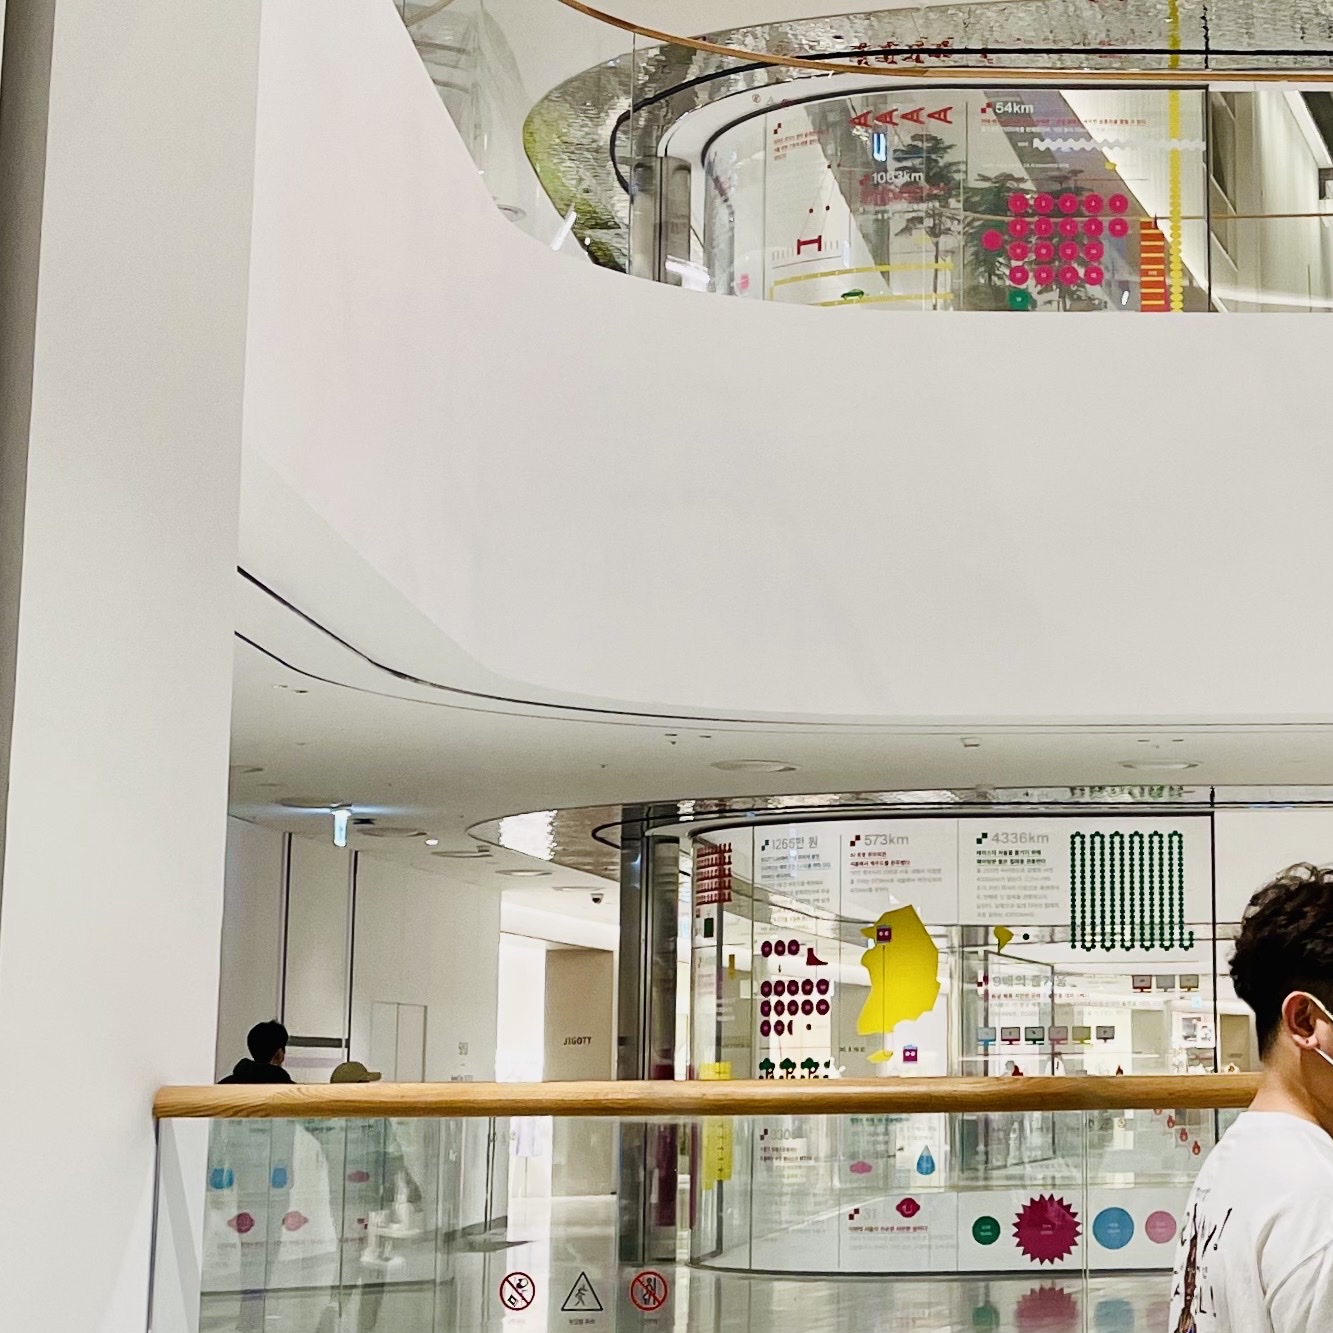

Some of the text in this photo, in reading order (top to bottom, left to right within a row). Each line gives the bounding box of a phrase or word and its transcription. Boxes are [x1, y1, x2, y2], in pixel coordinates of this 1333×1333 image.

[995, 102, 1034, 114] 54km
[864, 834, 909, 847] 573km
[991, 832, 1049, 844] 4336km
